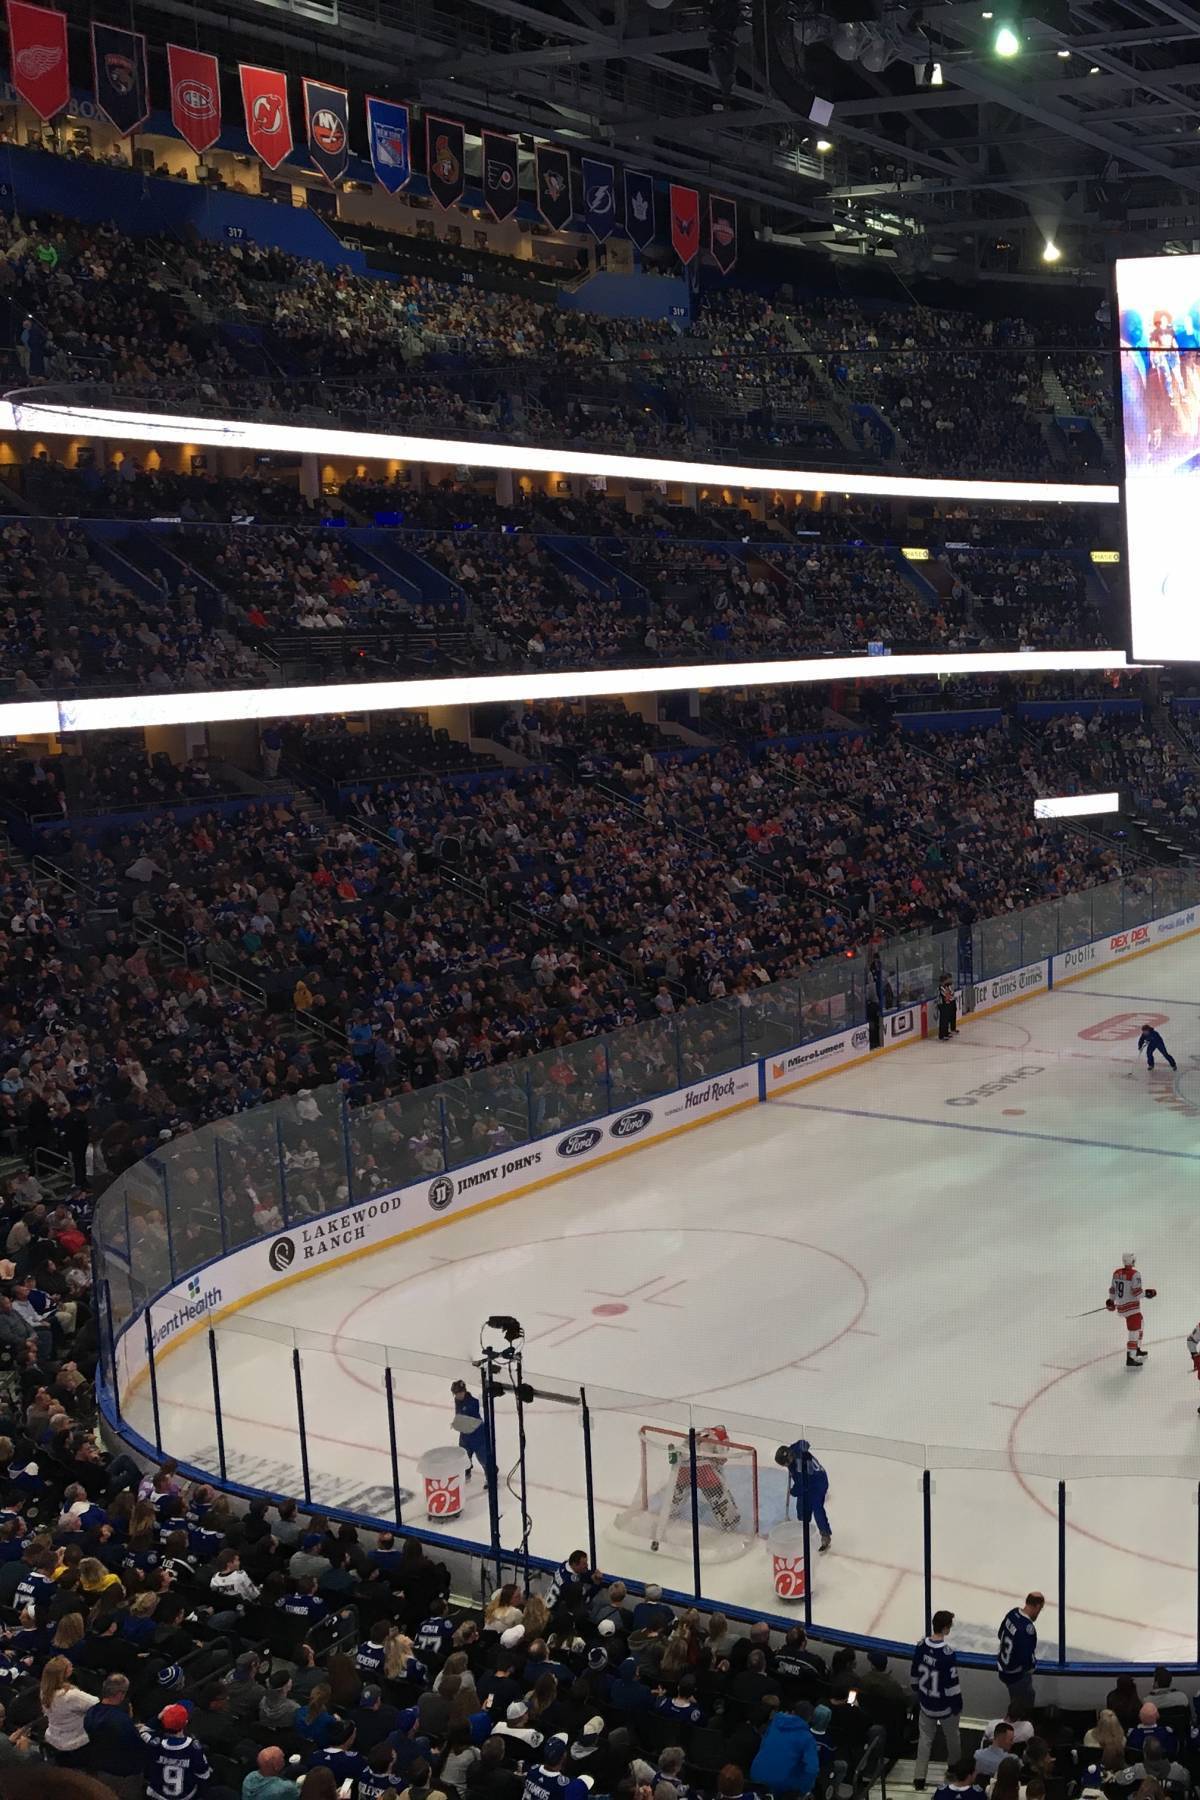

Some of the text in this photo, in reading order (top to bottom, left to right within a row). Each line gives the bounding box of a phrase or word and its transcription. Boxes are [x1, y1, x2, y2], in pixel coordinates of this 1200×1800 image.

[228, 226, 243, 238] 317
[672, 305, 686, 316] 319
[1110, 933, 1129, 950] DEX
[1131, 926, 1150, 943] DEX
[1065, 947, 1096, 968] Publix
[991, 979, 1018, 999] Times
[1018, 970, 1042, 989] Times
[855, 1030, 868, 1041] FOX
[787, 1041, 846, 1069] MicroLumen
[684, 1088, 710, 1110] Hard
[711, 1077, 736, 1102] Rock
[618, 1114, 646, 1135] Ford
[565, 1134, 595, 1155] Ford
[457, 1152, 541, 1195] JIMMY JOHN'S
[302, 1196, 402, 1243] LAKEWOOD
[303, 1225, 367, 1260] RANCH
[418, 1635, 443, 1654] 77
[918, 1664, 941, 1698] 21
[162, 1765, 184, 1796] 9
[524, 1779, 550, 1799] STAMKOS
